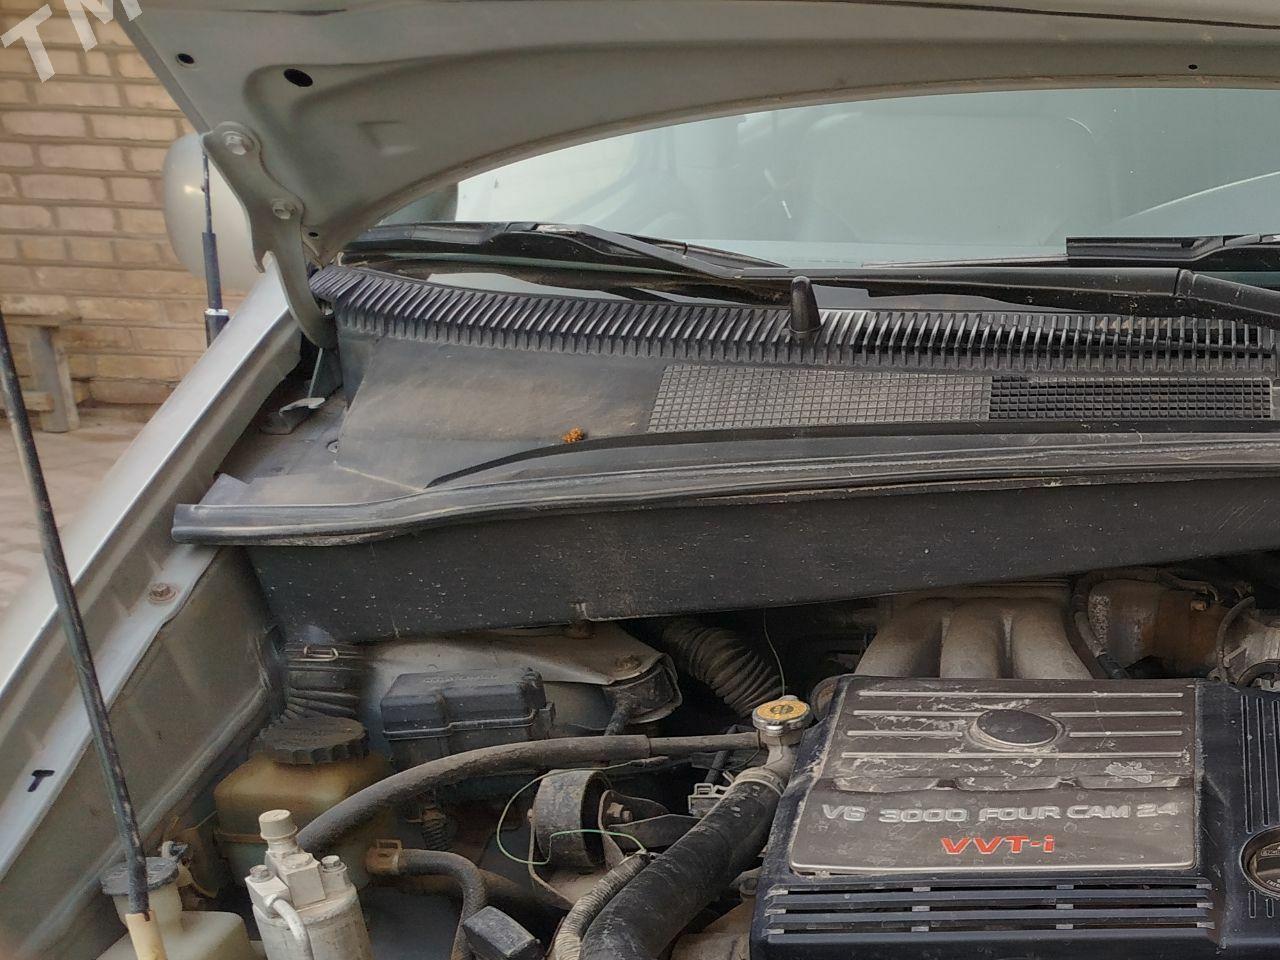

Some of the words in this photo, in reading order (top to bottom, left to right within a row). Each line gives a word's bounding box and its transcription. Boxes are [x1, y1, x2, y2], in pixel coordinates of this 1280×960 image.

[821, 803, 866, 821] V6
[878, 807, 967, 823] 3000
[978, 805, 1062, 821] FOUR
[1066, 804, 1130, 819] CAM
[1136, 802, 1180, 818] 24
[940, 834, 1056, 855] VVT-i
